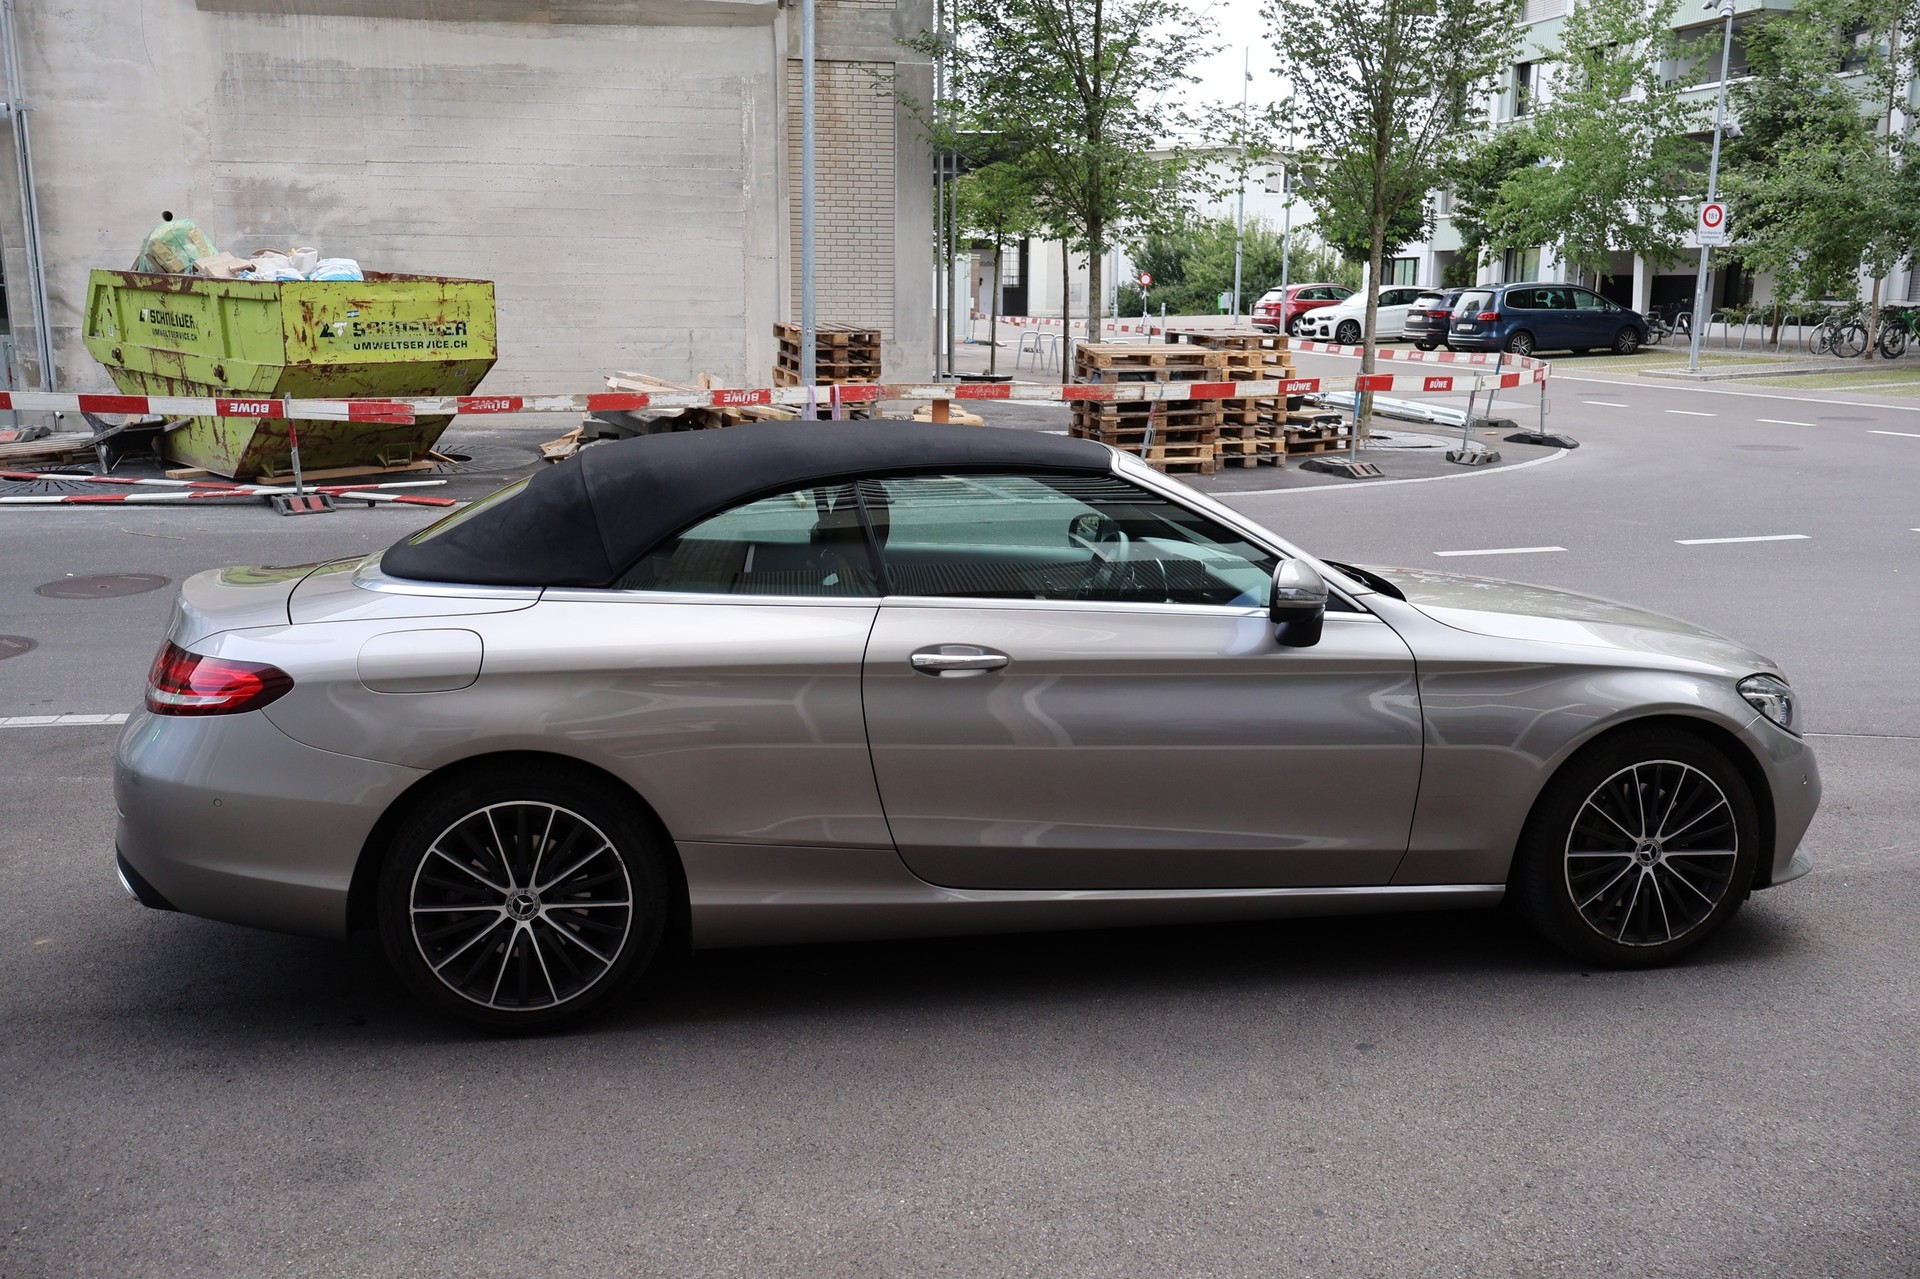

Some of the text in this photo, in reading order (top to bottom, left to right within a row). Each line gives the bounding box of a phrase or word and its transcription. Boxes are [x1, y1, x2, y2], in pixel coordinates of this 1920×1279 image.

[353, 340, 468, 351] UMWELTSERVICE.CH
[1286, 381, 1312, 391] BÜWE
[1429, 379, 1448, 388] BÜWE
[723, 392, 760, 404] BÜWE
[230, 402, 270, 415] BÜWE
